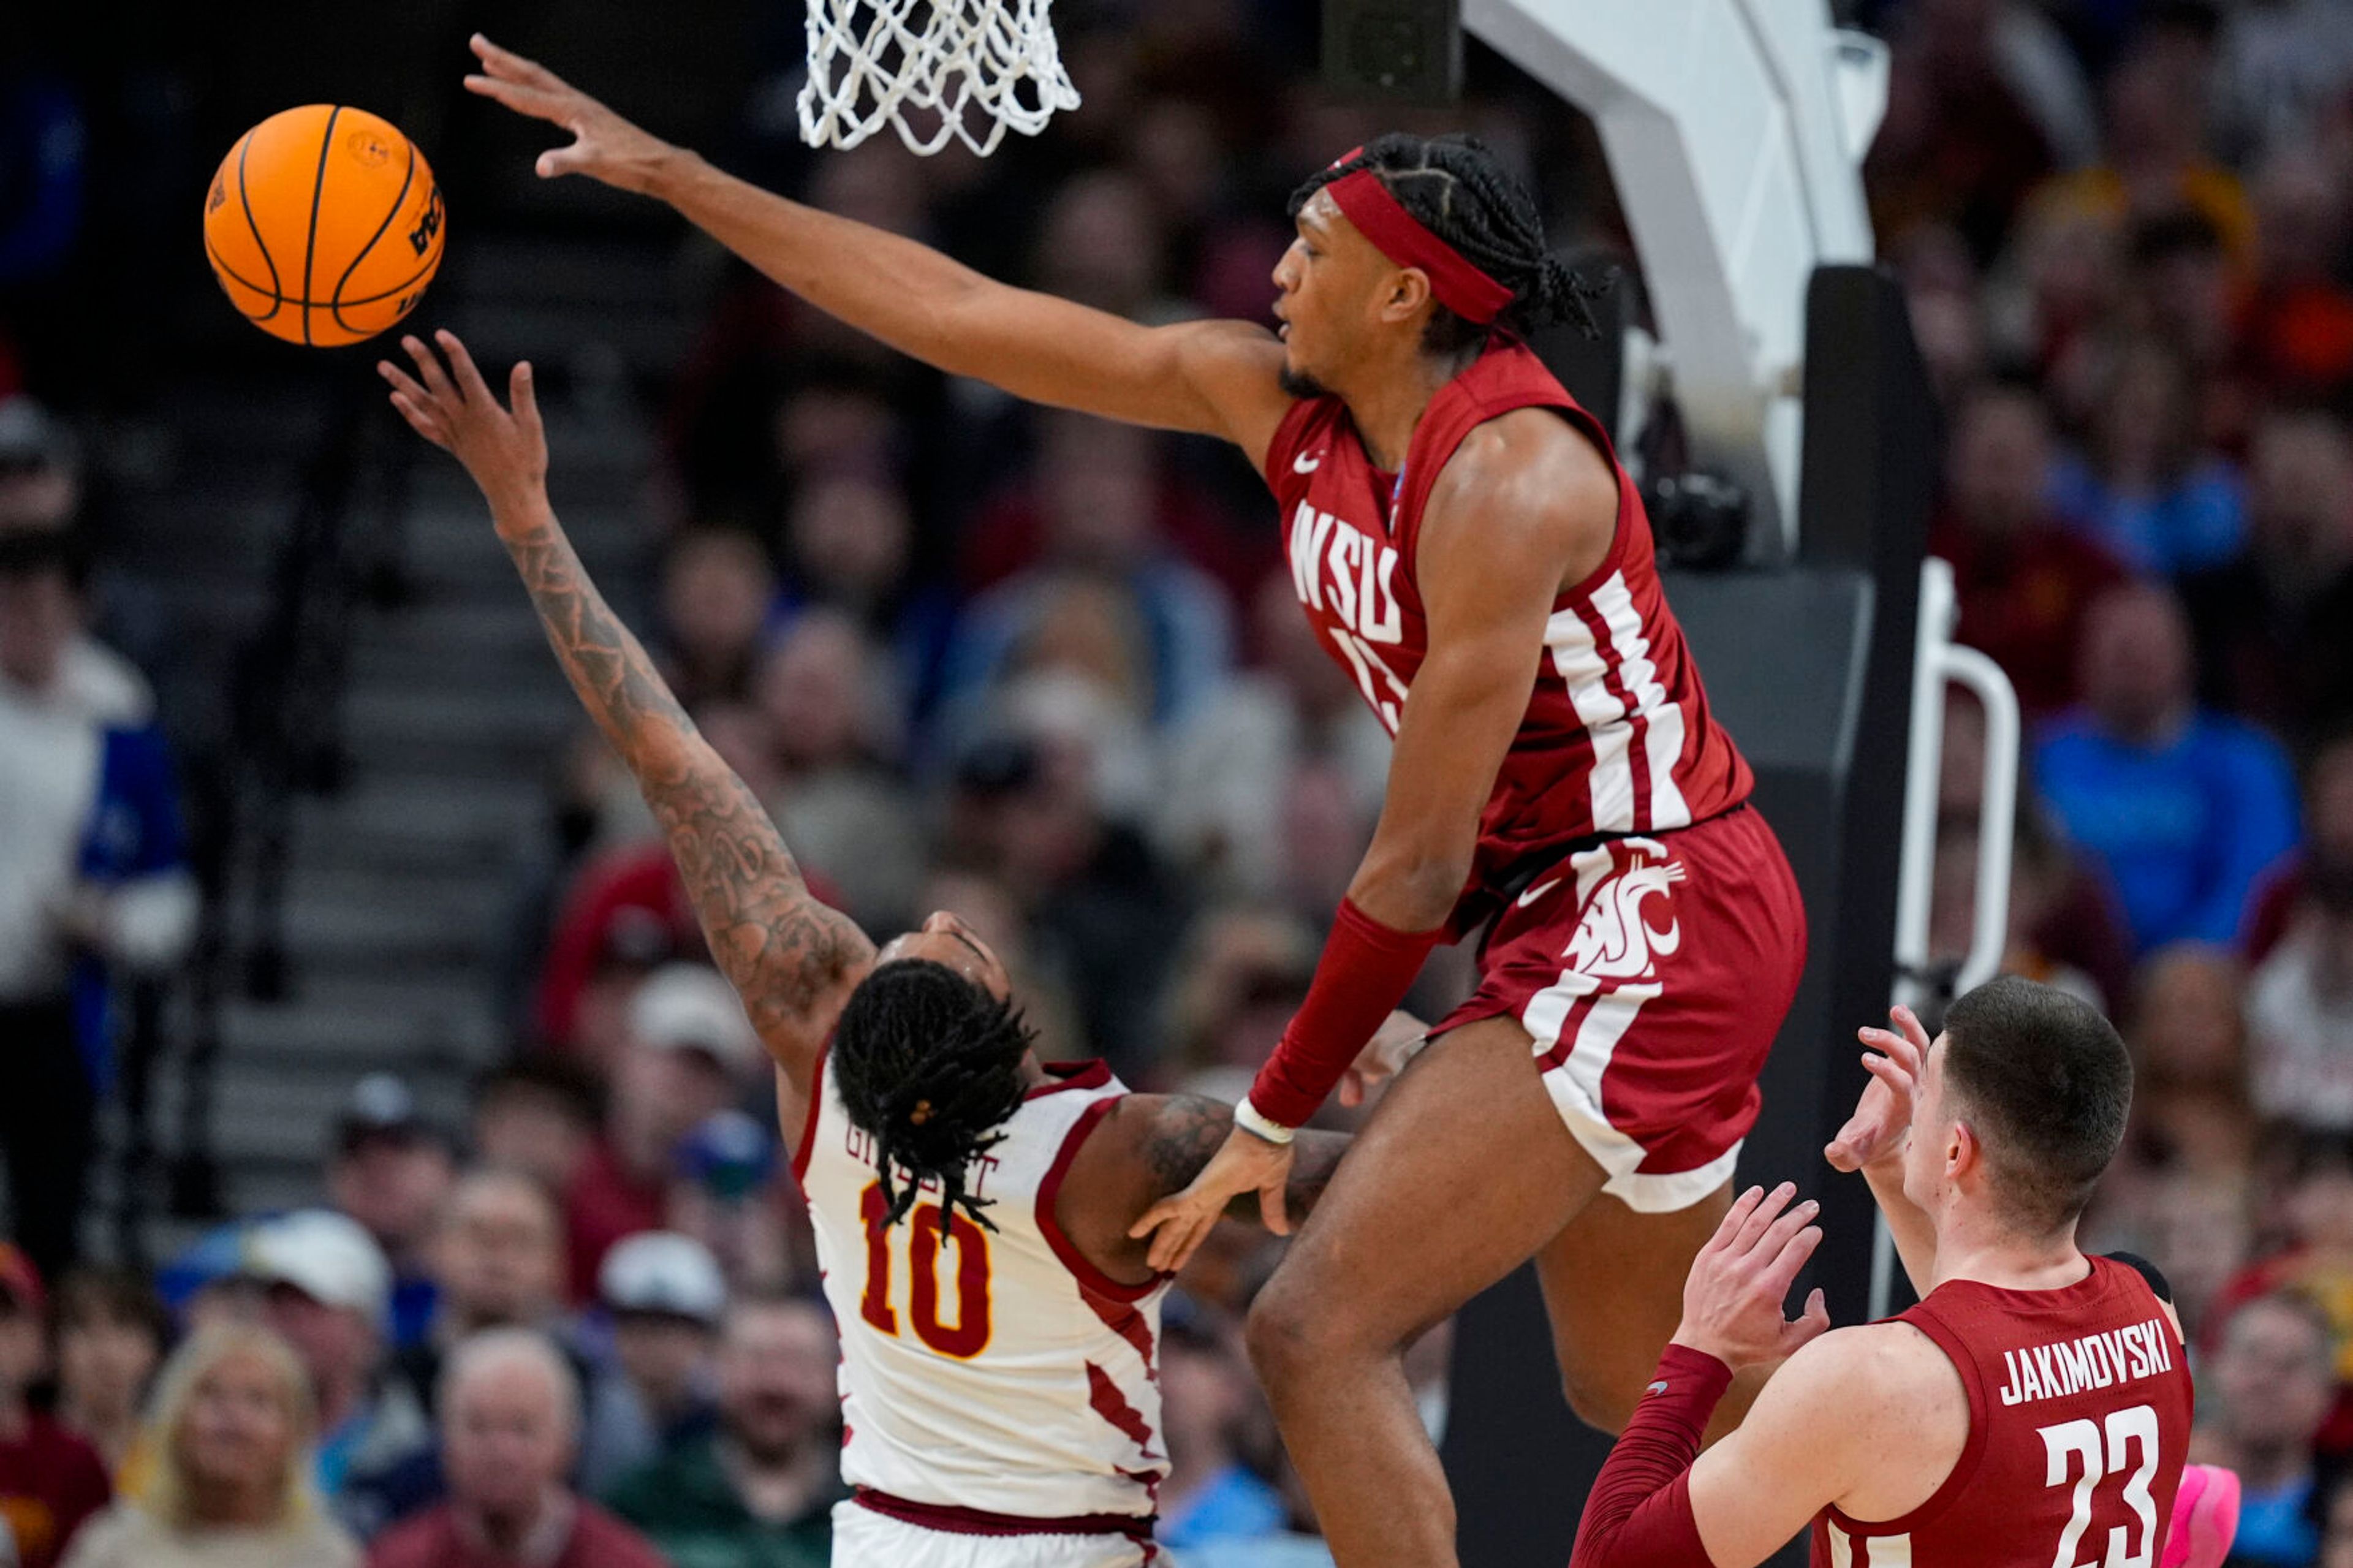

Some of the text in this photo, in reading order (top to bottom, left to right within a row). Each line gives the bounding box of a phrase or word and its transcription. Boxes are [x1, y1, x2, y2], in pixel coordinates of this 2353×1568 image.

[1290, 499, 1402, 643] WSU
[860, 1180, 990, 1358] 10
[2000, 1319, 2172, 1406] JAKIMOVSKI
[2036, 1405, 2159, 1568] 23
